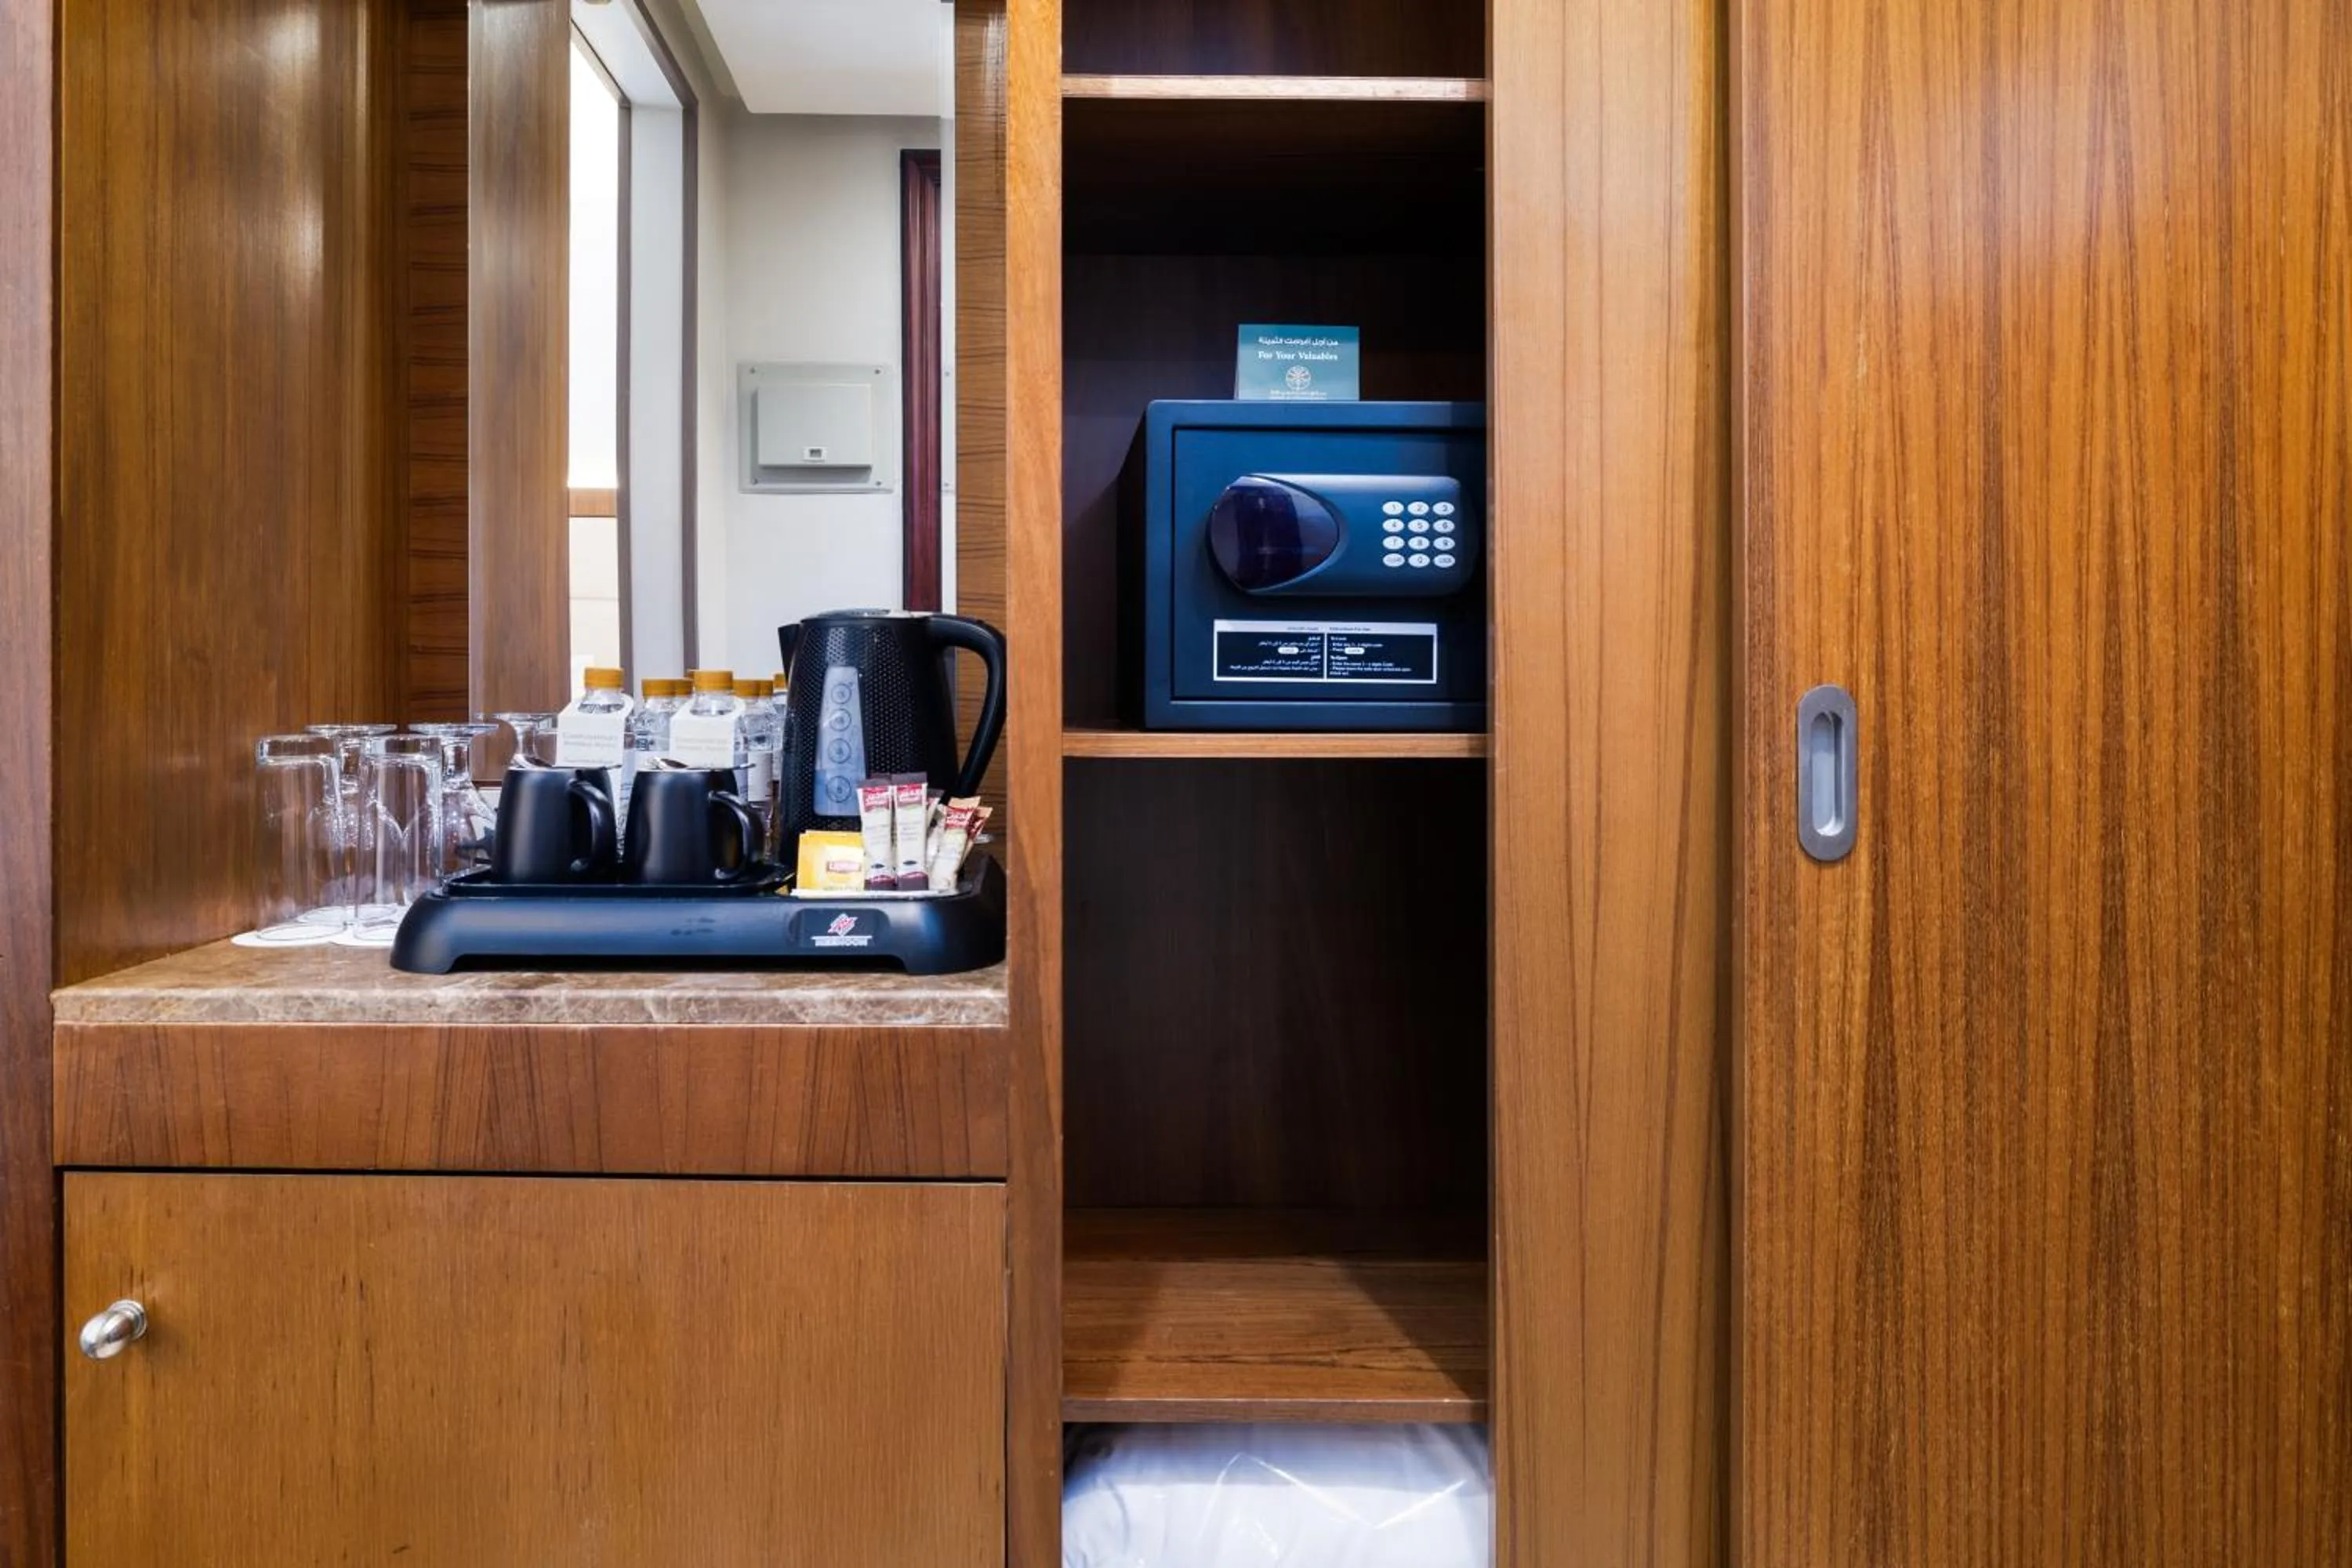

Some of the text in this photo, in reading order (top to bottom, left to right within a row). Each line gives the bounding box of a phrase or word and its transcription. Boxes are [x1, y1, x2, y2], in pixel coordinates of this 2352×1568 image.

[1258, 351, 1338, 361] For Your Valuables
